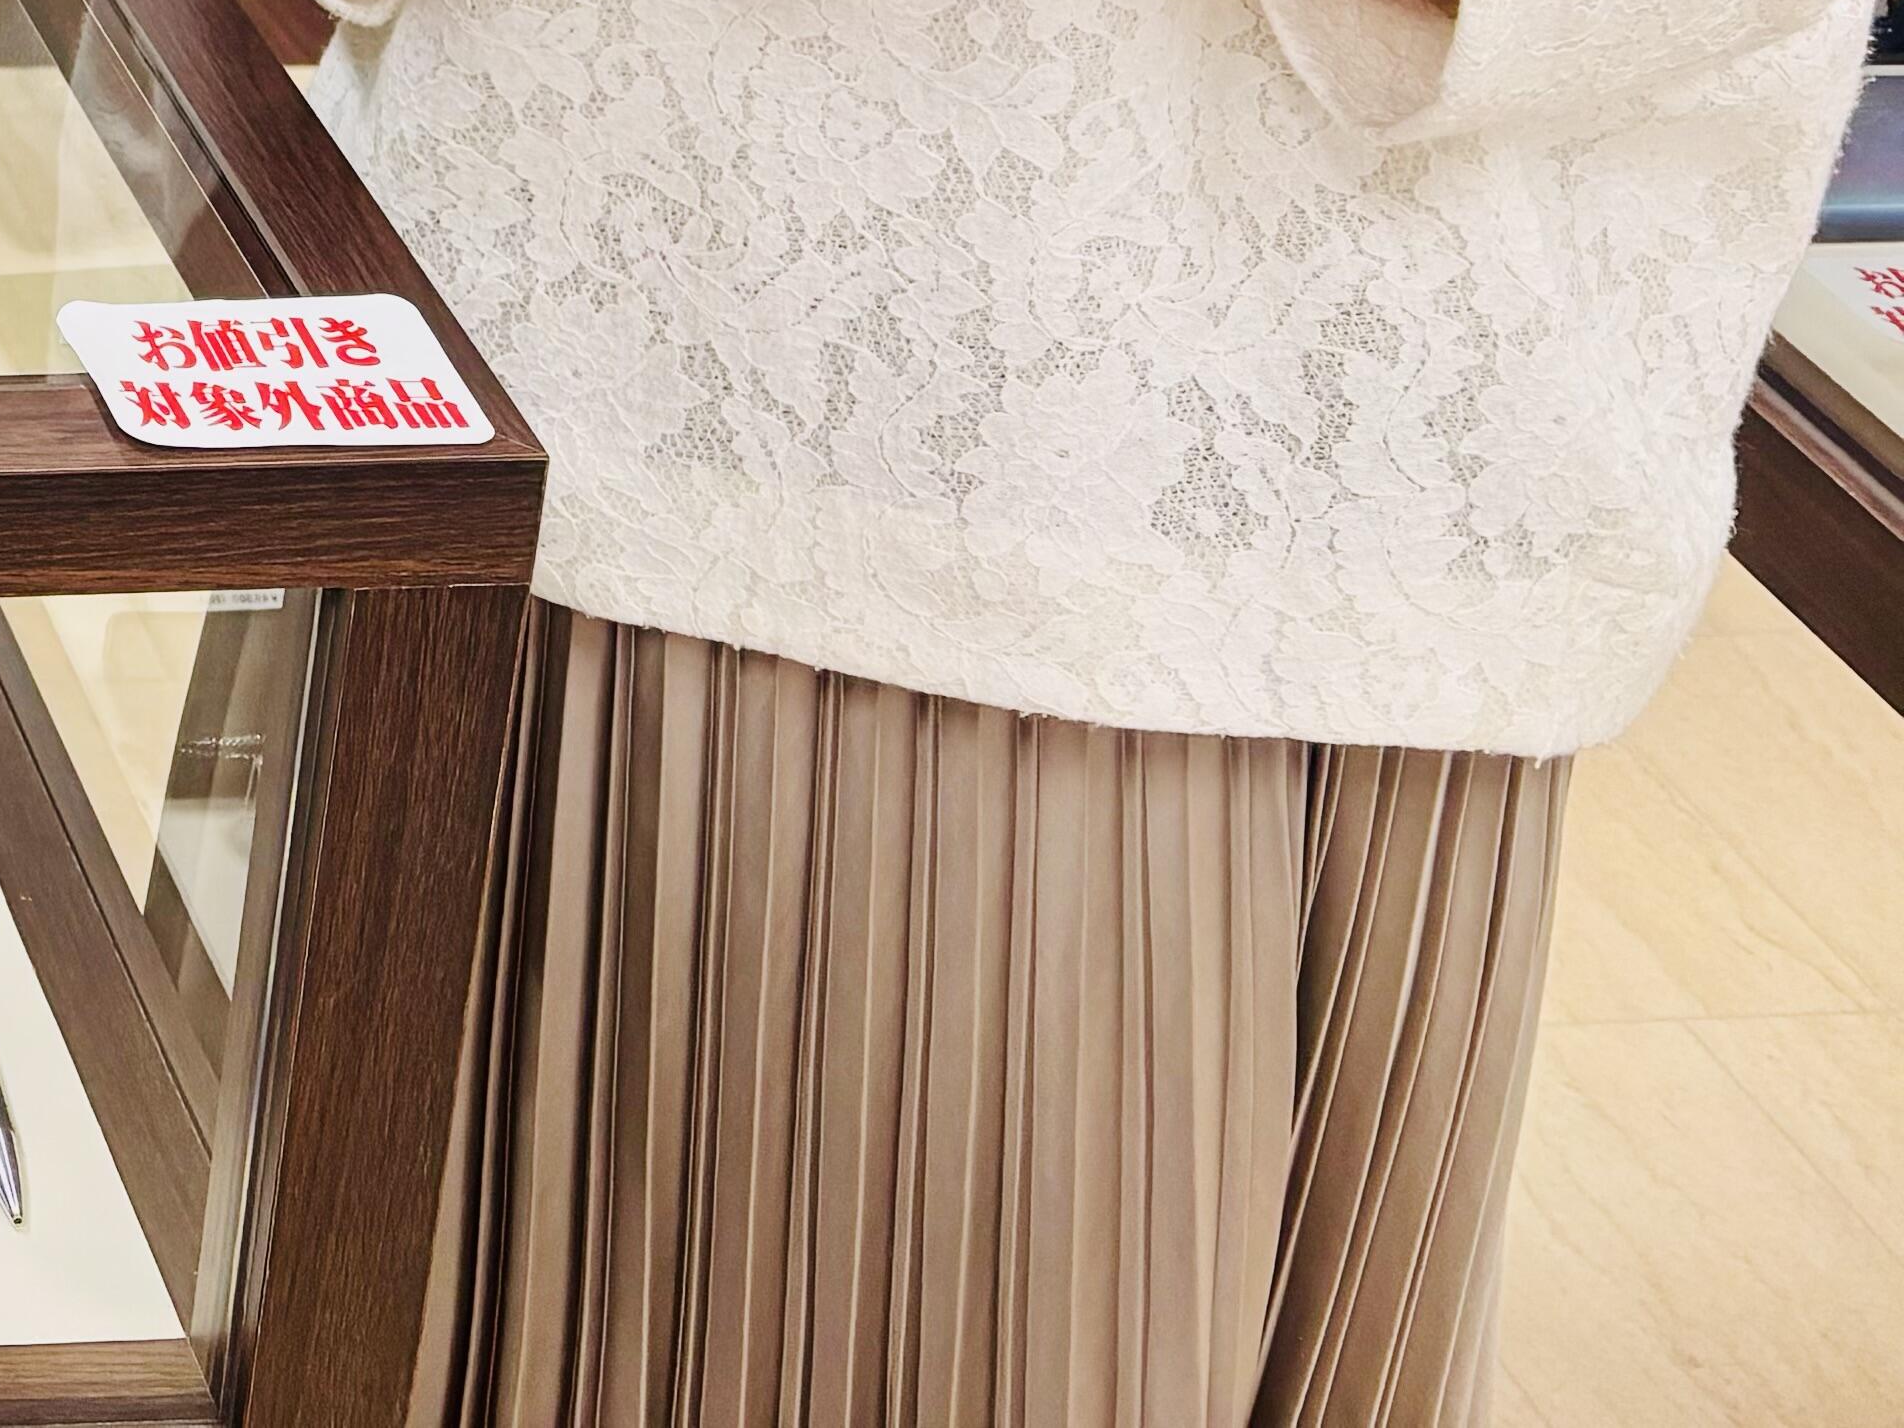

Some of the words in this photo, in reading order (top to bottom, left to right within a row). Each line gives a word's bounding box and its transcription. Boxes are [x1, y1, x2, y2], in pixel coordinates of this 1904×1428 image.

[132, 317, 381, 373] お値引き
[118, 377, 470, 432] 対象外商品
